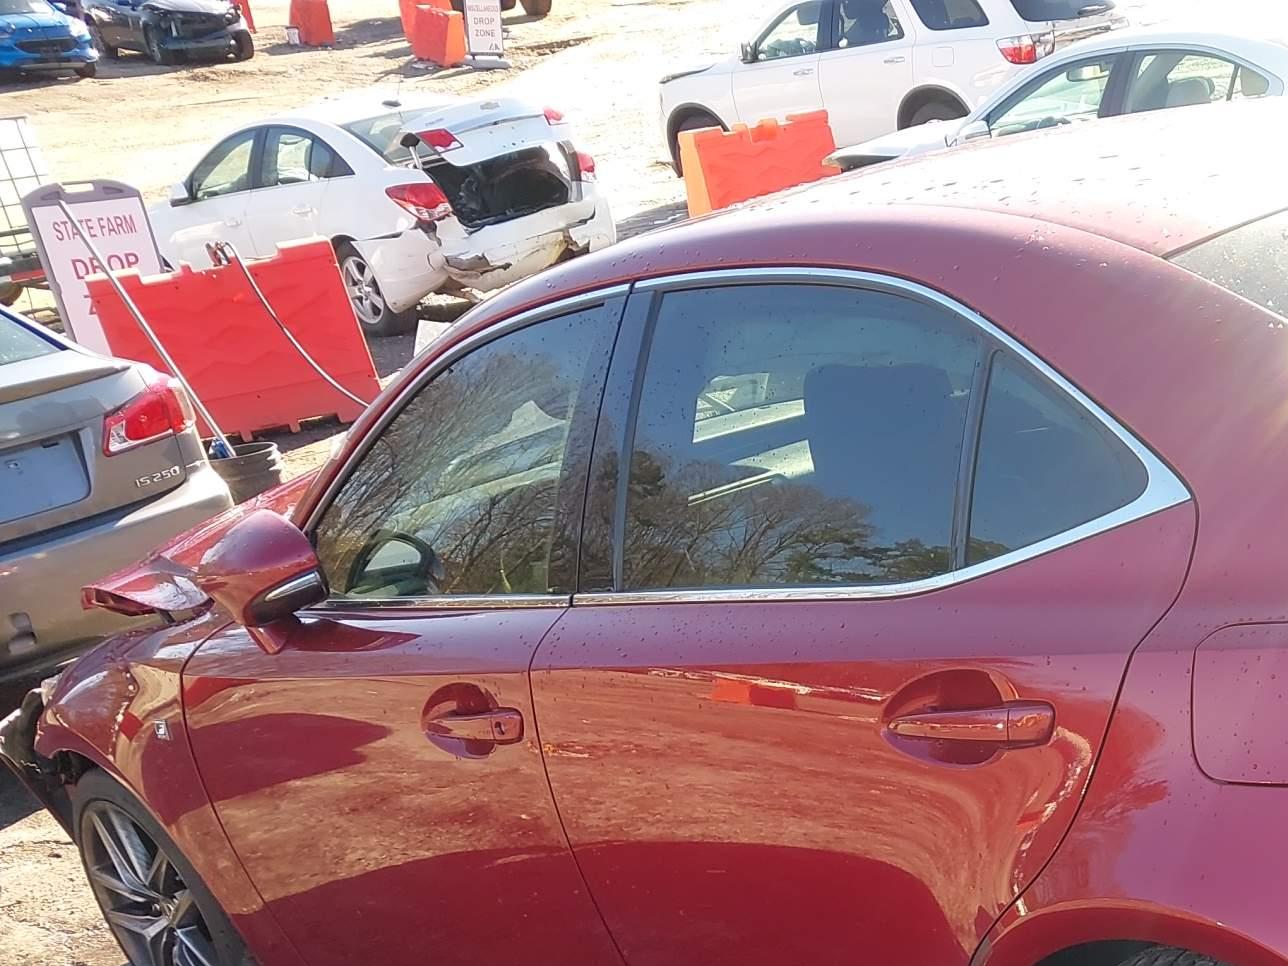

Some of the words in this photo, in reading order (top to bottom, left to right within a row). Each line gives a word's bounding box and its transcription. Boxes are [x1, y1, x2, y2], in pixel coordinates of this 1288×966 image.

[473, 16, 495, 25] DROP
[474, 29, 496, 37] ZONE
[52, 217, 97, 241] STATE
[97, 214, 137, 237] FARM
[135, 476, 150, 488] IS
[152, 465, 180, 482] 250
